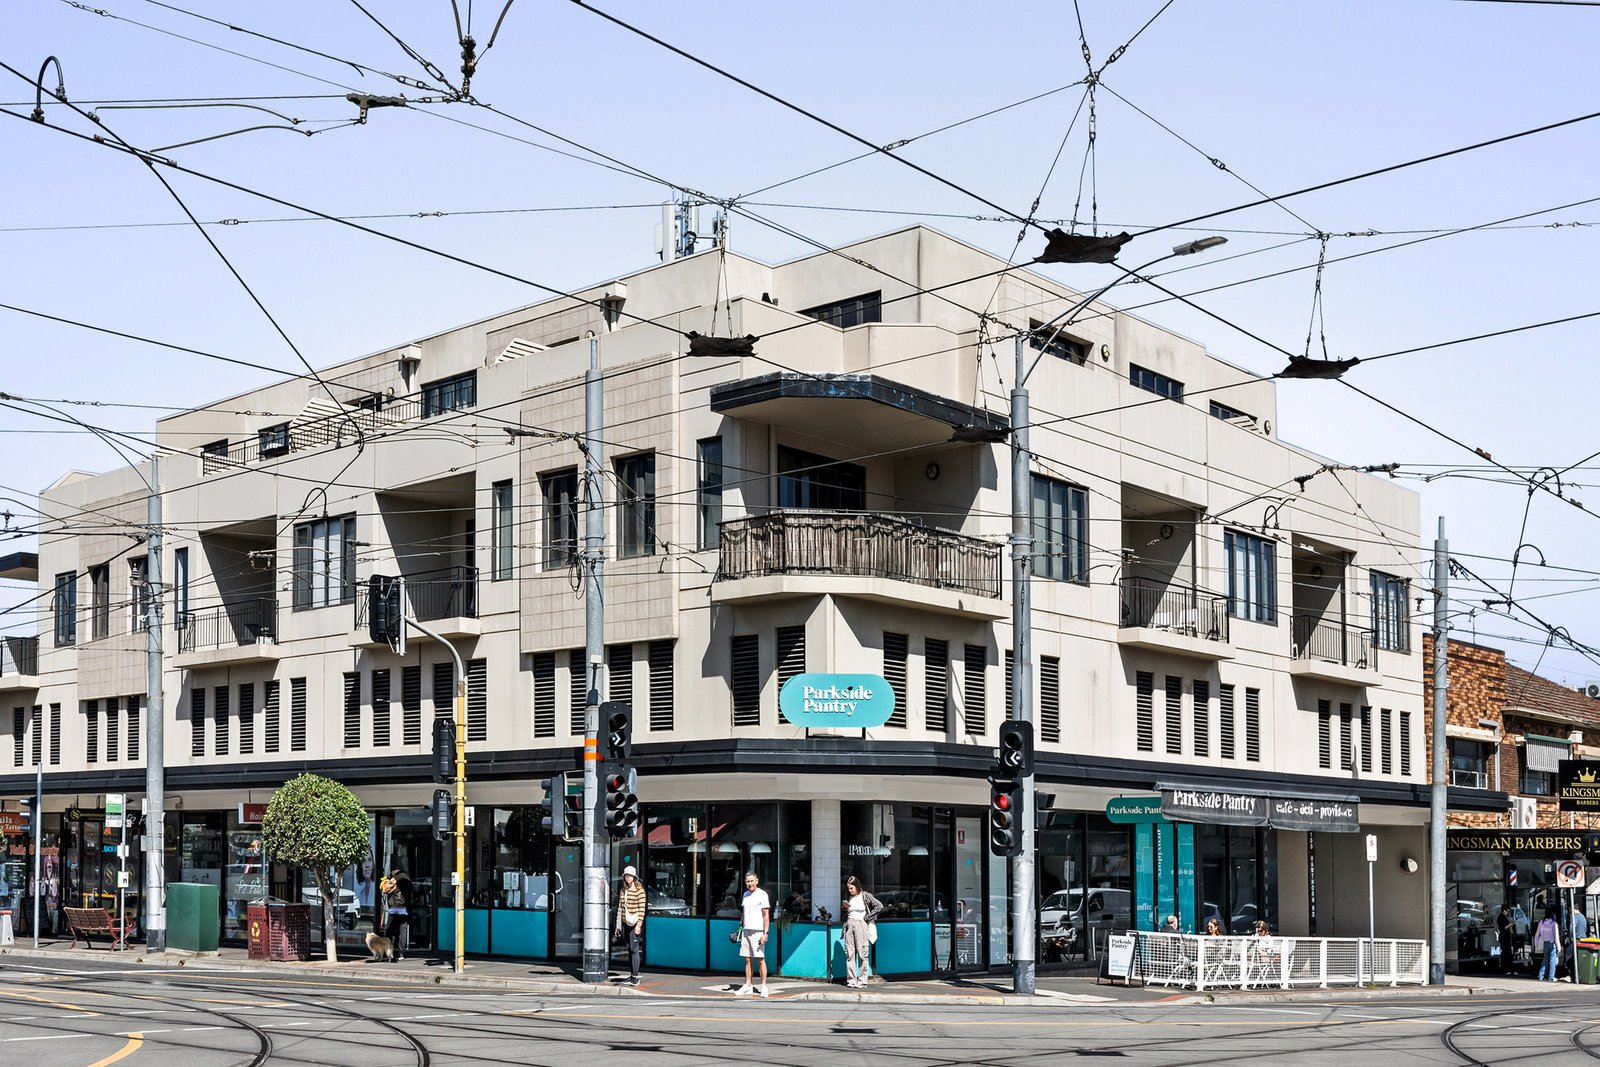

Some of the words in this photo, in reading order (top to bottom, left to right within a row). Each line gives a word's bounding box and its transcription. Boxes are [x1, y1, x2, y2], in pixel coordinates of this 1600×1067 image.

[803, 685, 873, 700] Parkside
[803, 699, 858, 717] Pantry
[1562, 787, 1600, 797] KINGSM
[1173, 790, 1222, 809] Parkside
[1222, 793, 1256, 815] Pantry
[1110, 806, 1143, 814] Parkside
[1144, 806, 1162, 814] Pant
[1446, 837, 1511, 849] INGSMAN
[1514, 837, 1582, 850] BARBERS
